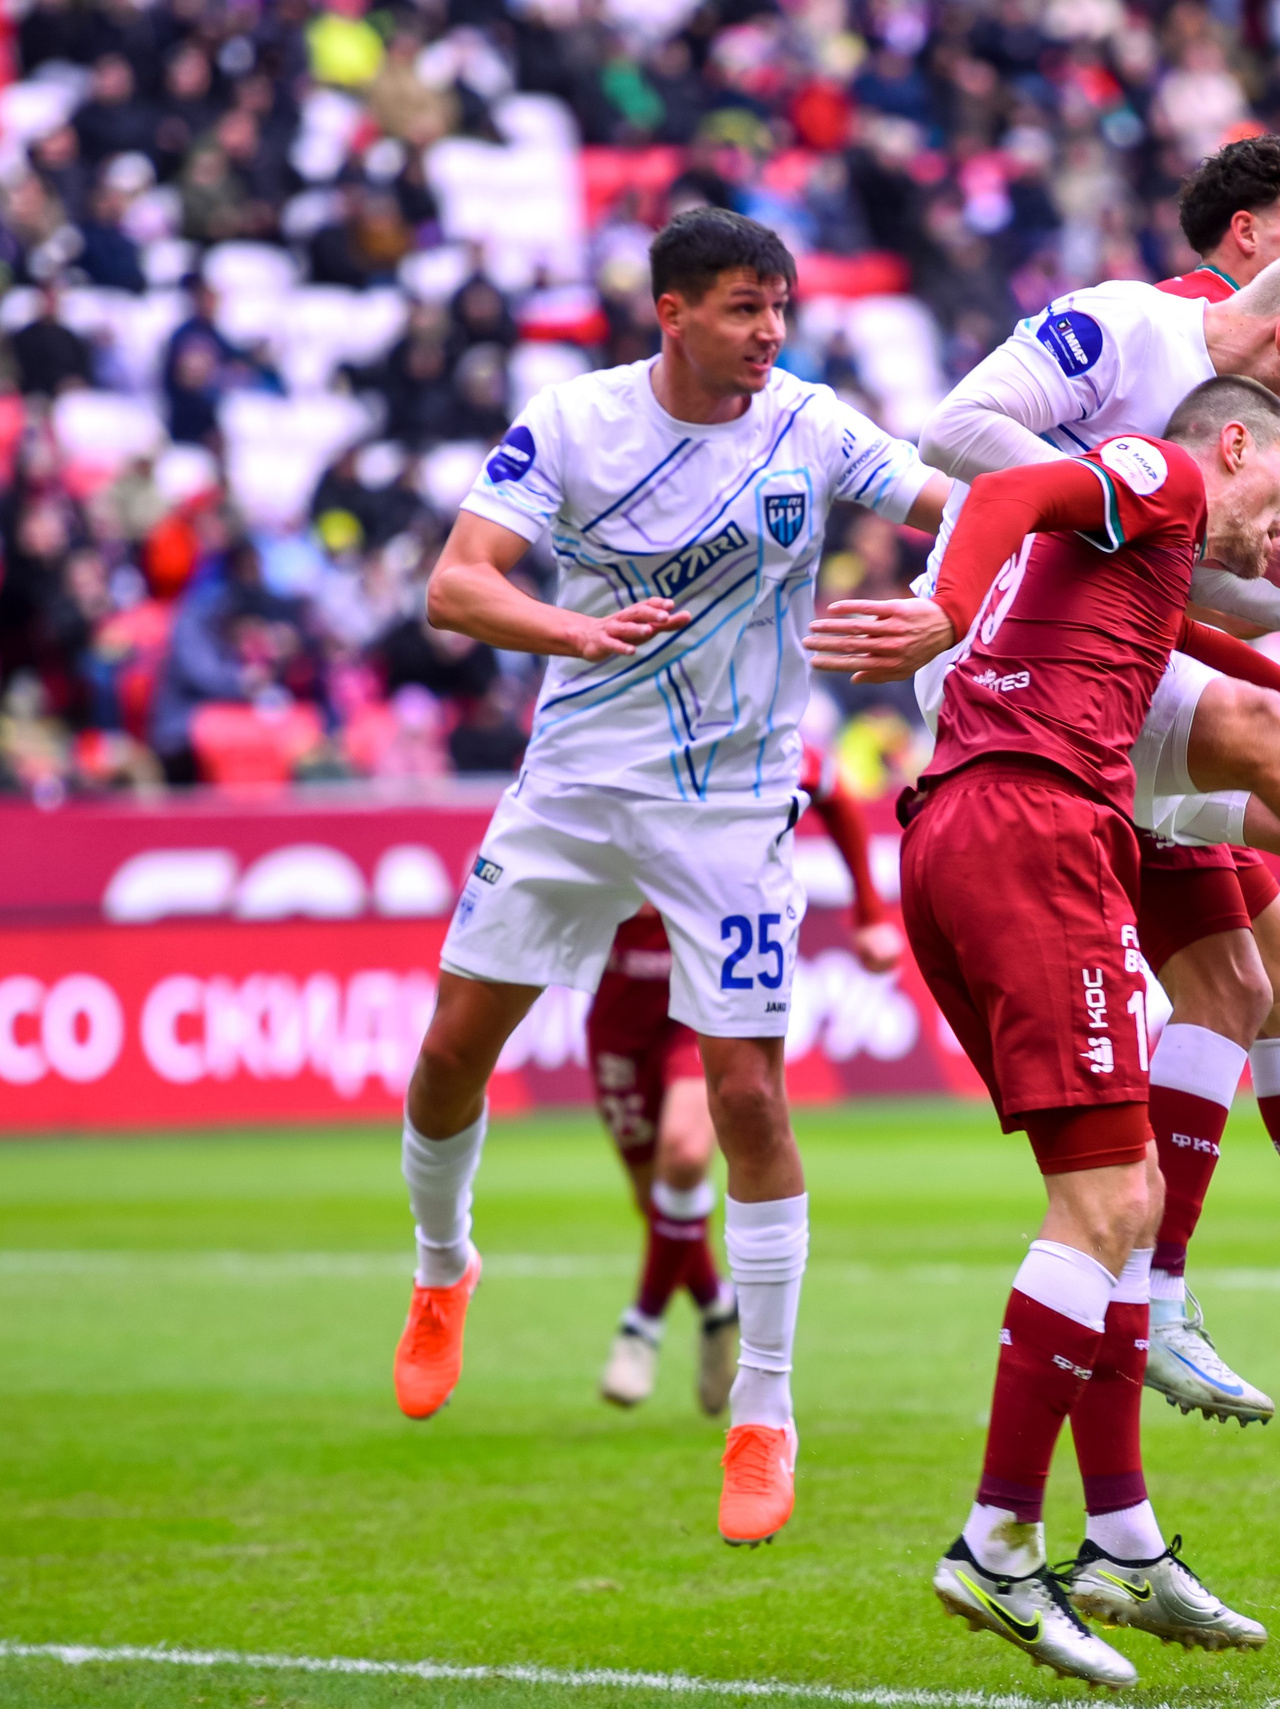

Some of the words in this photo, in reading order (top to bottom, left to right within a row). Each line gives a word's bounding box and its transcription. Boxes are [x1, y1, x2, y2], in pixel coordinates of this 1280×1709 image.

[1064, 332, 1089, 365] МИР
[655, 525, 744, 598] PARI
[720, 913, 784, 989] 25
